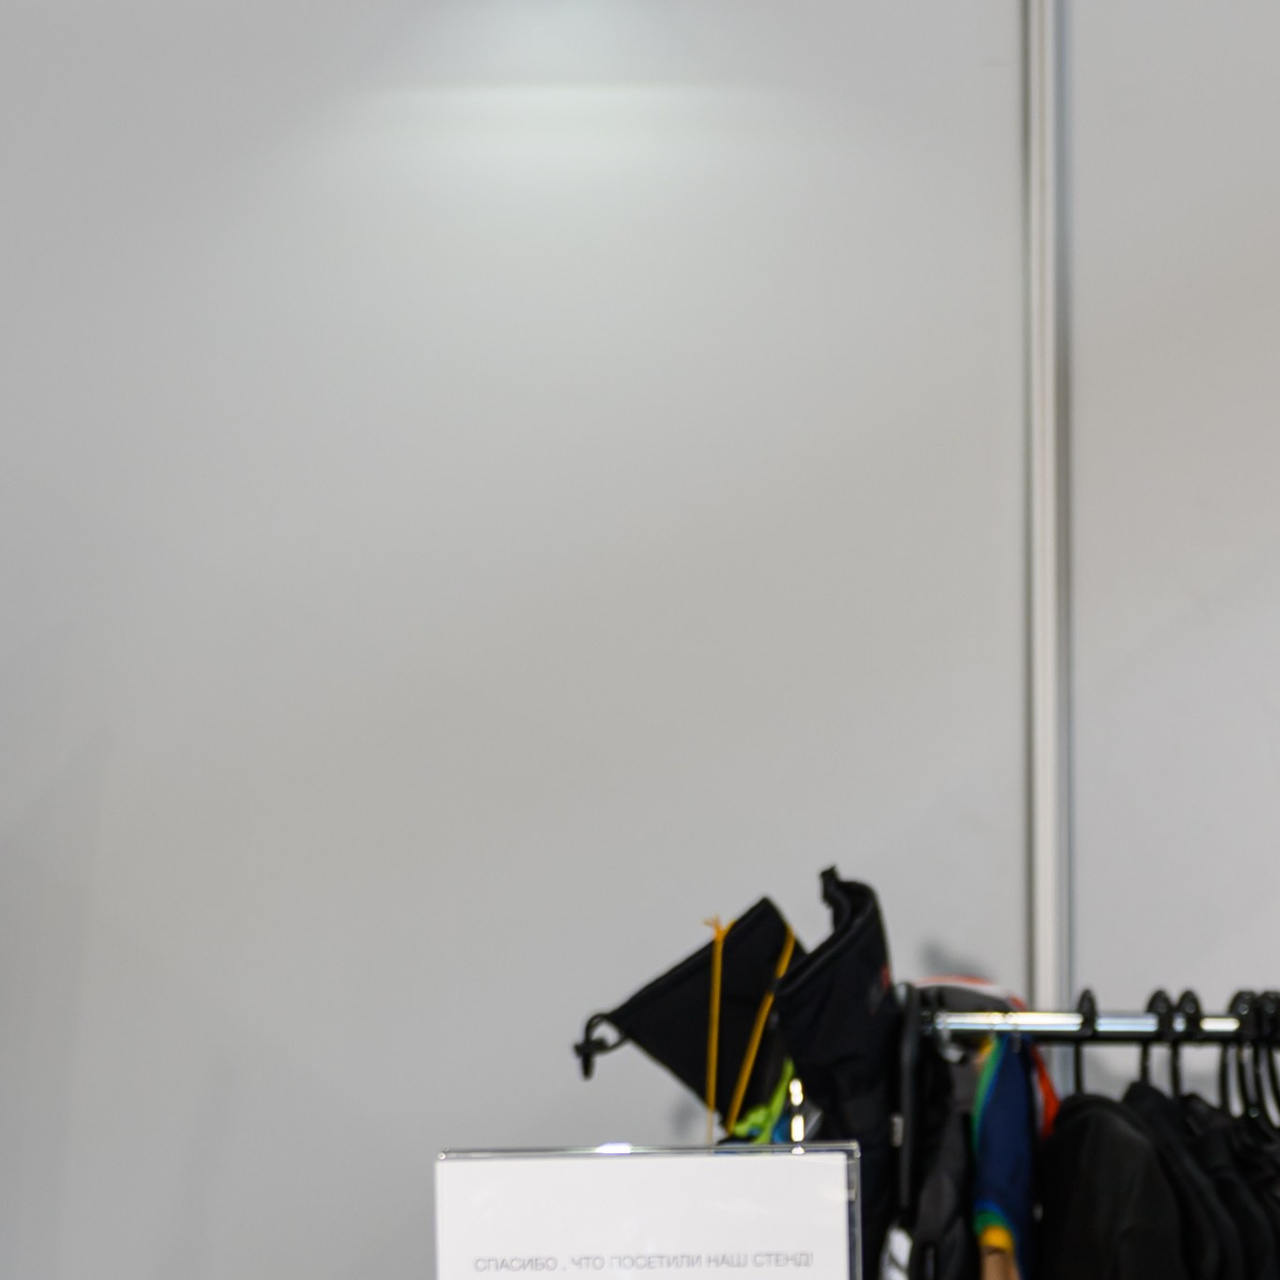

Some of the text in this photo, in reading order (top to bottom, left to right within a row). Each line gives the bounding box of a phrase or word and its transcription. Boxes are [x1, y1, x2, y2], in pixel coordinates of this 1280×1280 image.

[474, 1256, 558, 1273] СПАСИБО
[571, 1255, 606, 1271] ЧТО
[610, 1253, 702, 1270] ПОСЕТИЛИ
[708, 1253, 749, 1269] НАШ
[752, 1252, 814, 1269] СТЕНД!
